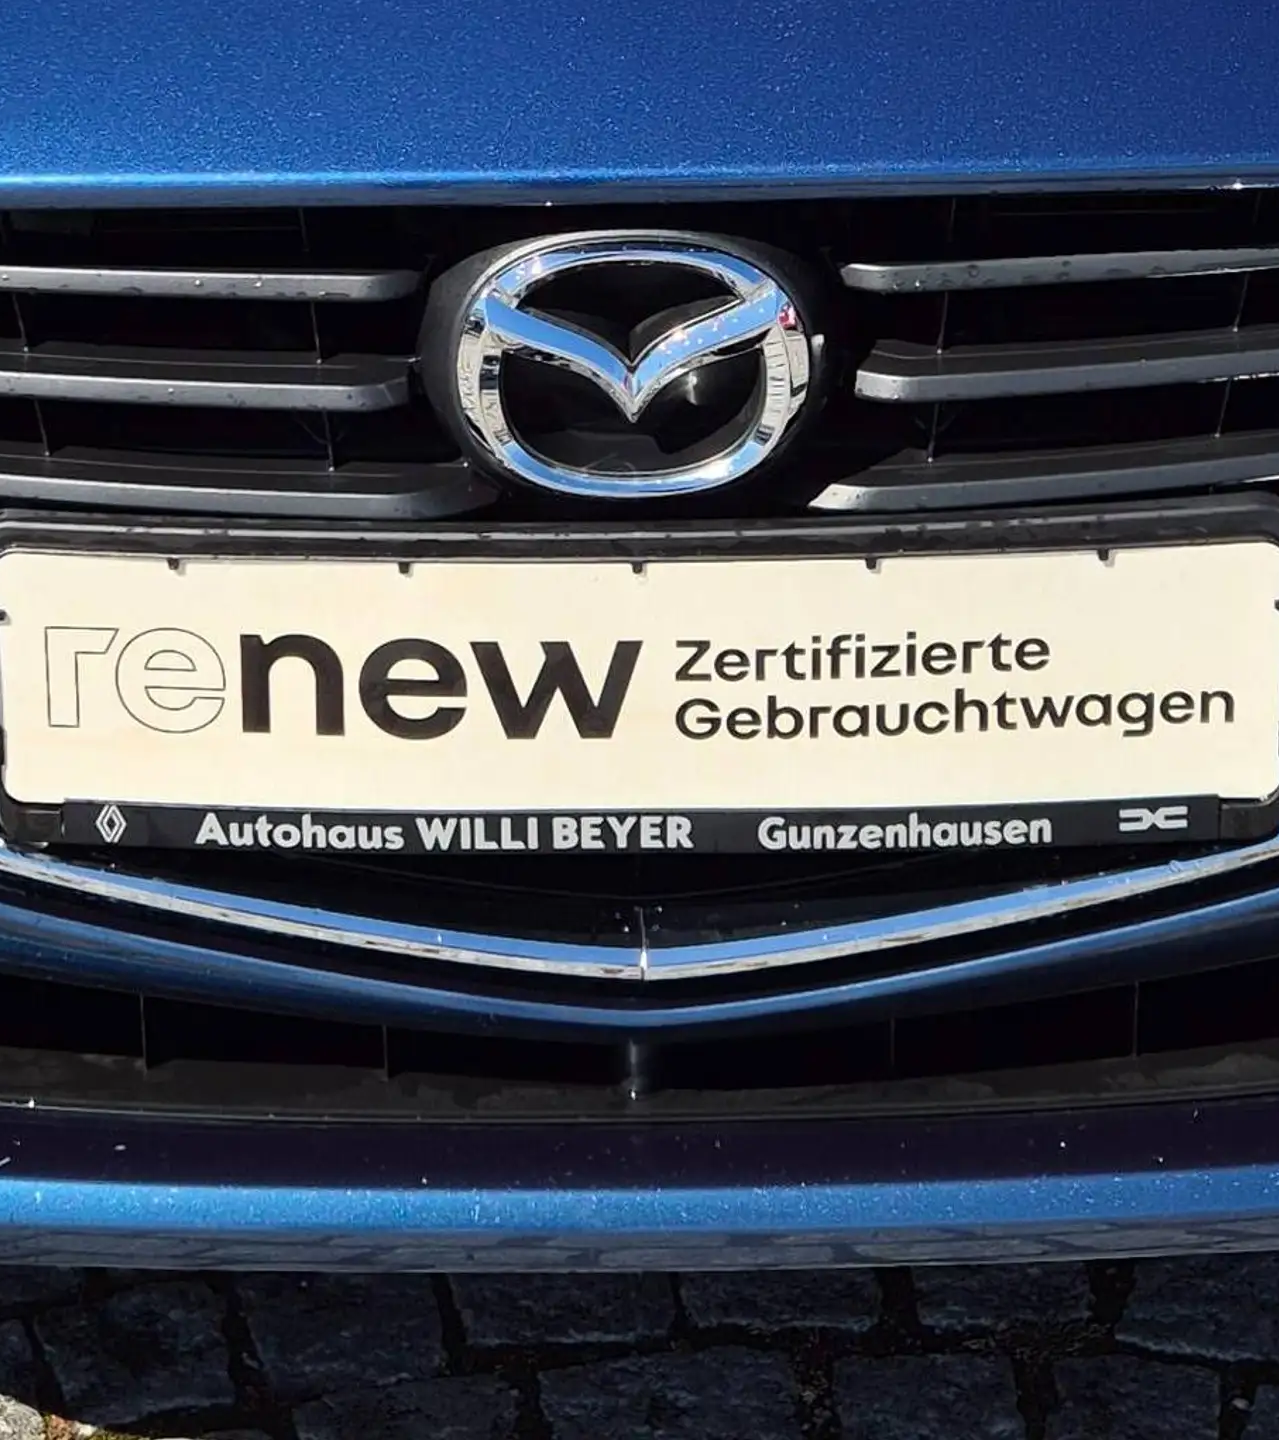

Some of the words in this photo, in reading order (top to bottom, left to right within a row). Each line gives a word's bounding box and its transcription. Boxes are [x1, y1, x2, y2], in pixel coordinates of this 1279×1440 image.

[44, 626, 643, 740] renew
[675, 630, 1051, 683] Zertifizierte
[674, 686, 1236, 740] Gebrauchtwagen
[195, 812, 405, 851] Autohaus
[415, 816, 539, 851] WILLI
[552, 816, 694, 850] BEYER
[757, 812, 1053, 851] Gunzenhausen
